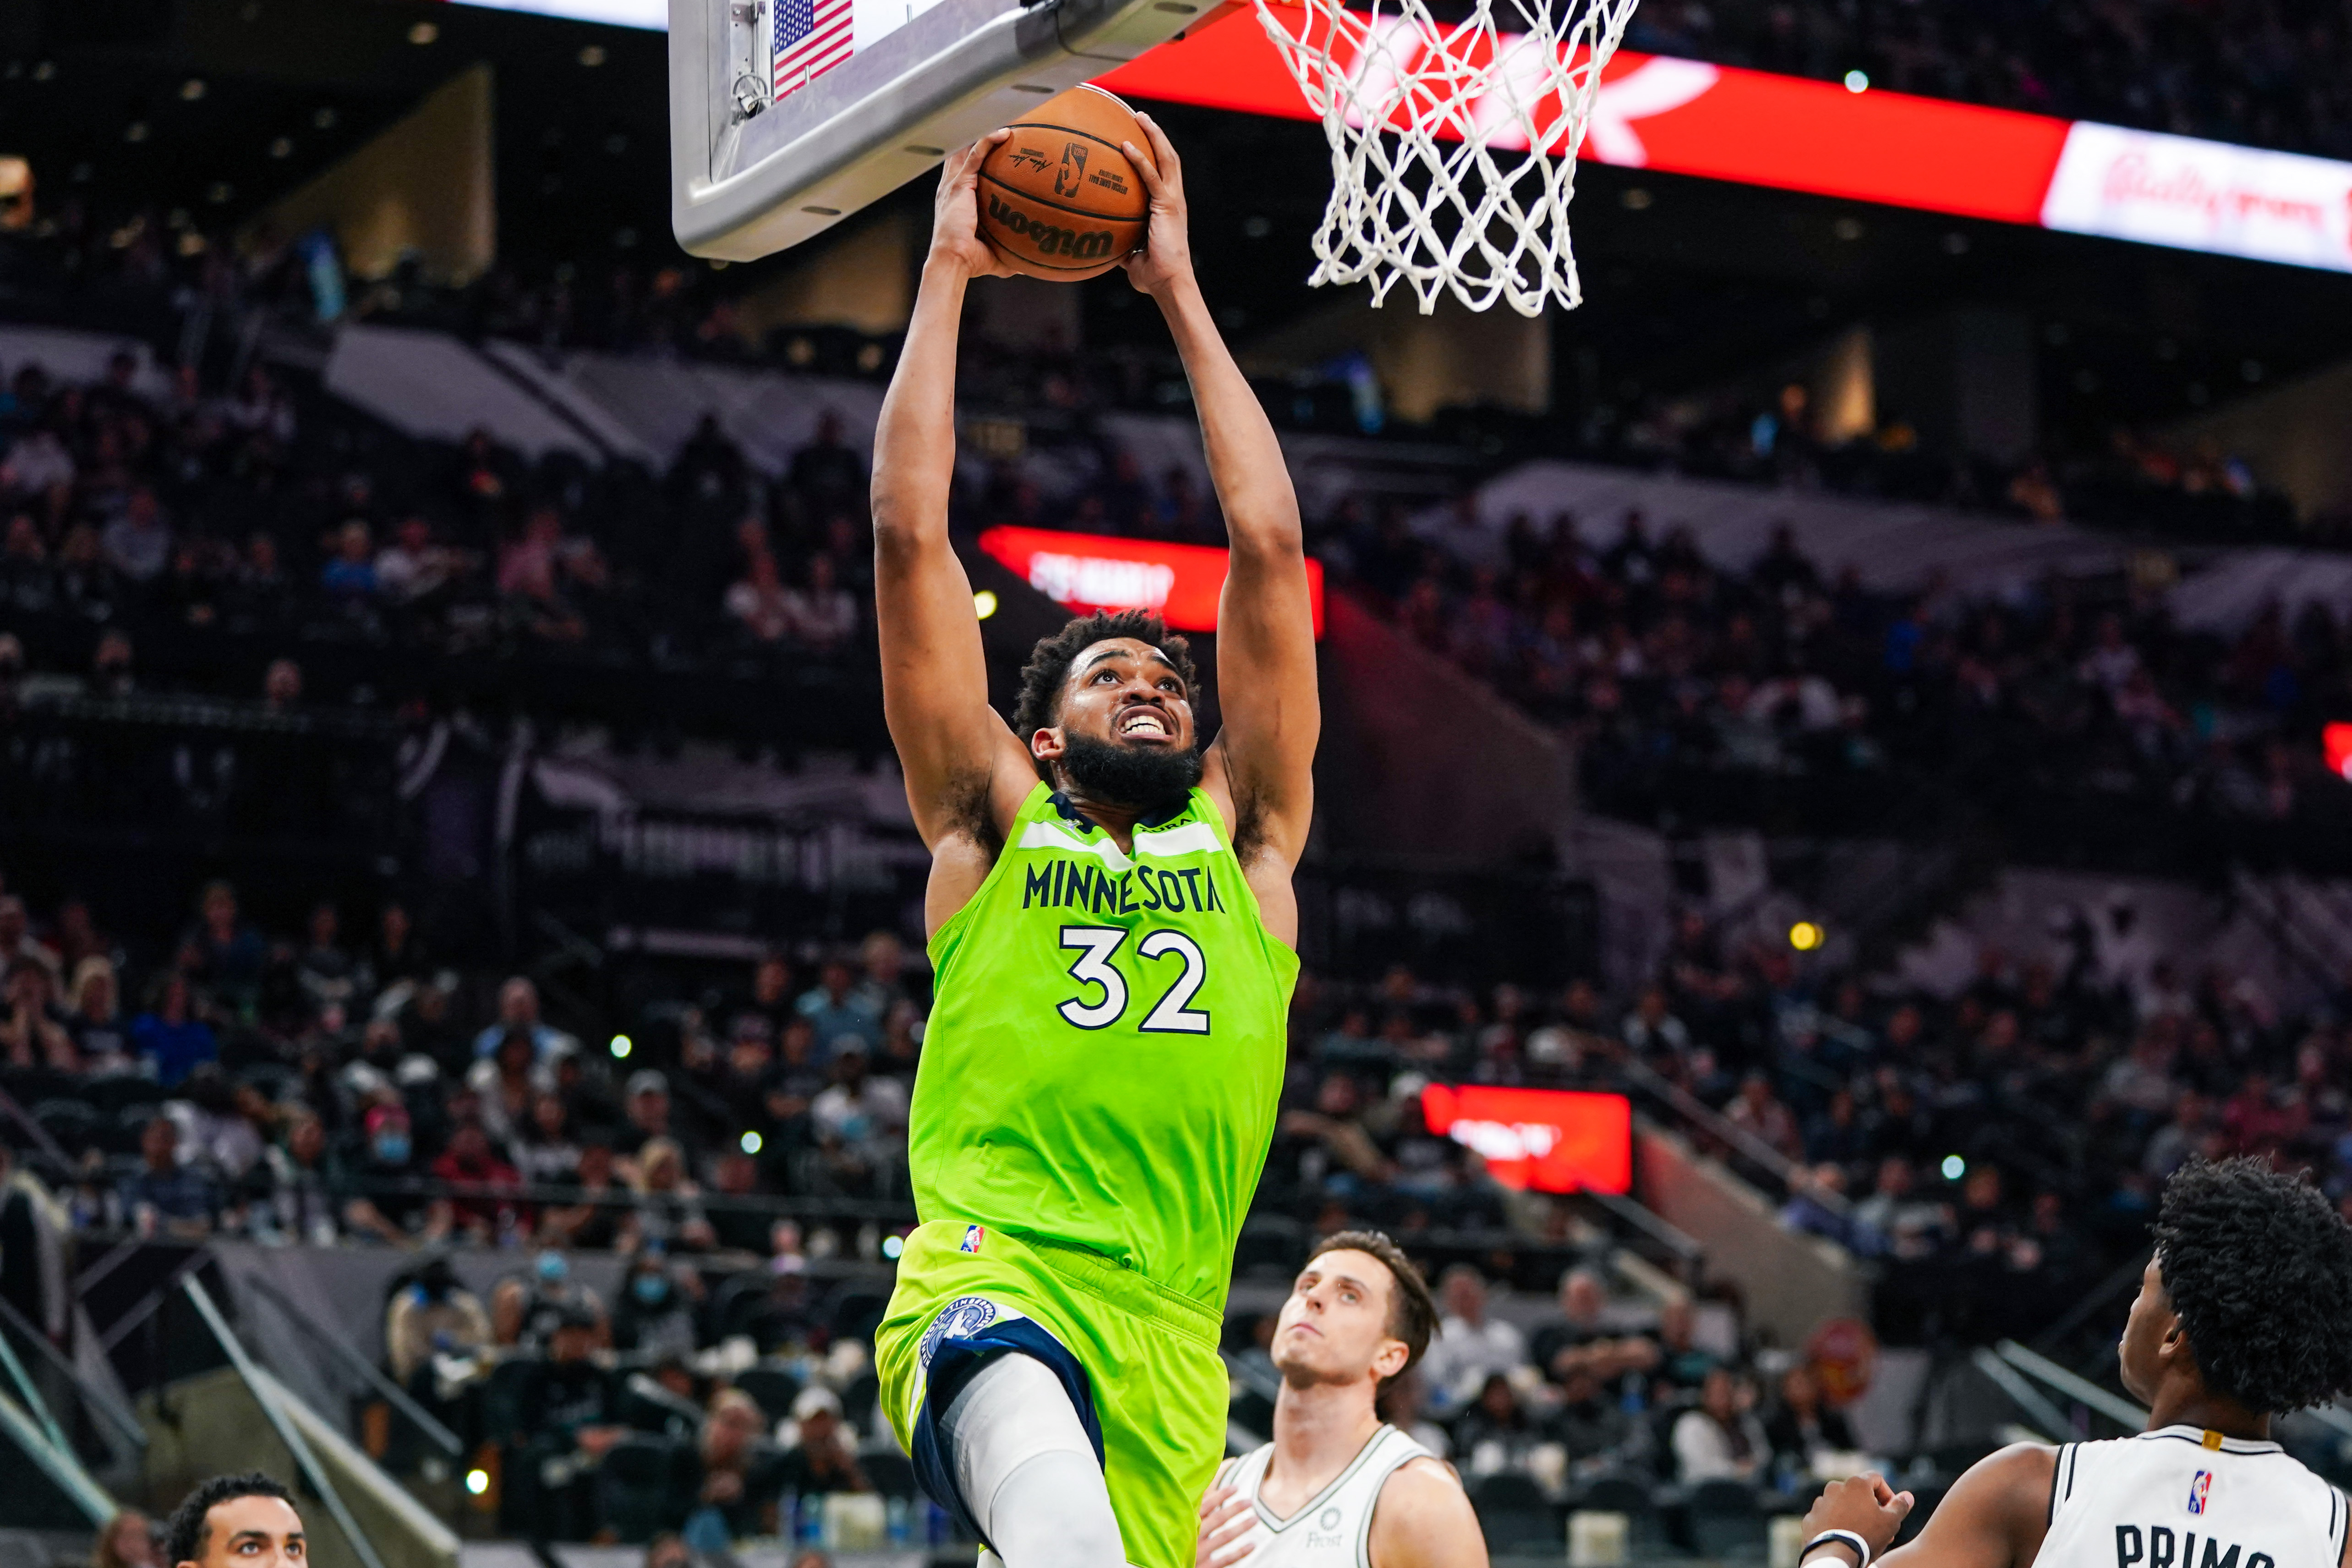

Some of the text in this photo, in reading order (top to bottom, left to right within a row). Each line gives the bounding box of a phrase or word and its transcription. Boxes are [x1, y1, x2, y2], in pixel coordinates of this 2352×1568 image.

[989, 193, 1114, 259] Wilson
[1023, 859, 1226, 916] MINNESOTA
[1056, 925, 1210, 1035] 32
[949, 1298, 994, 1328] TIMBERWOLVES
[2116, 1524, 2275, 1568] PRIM
